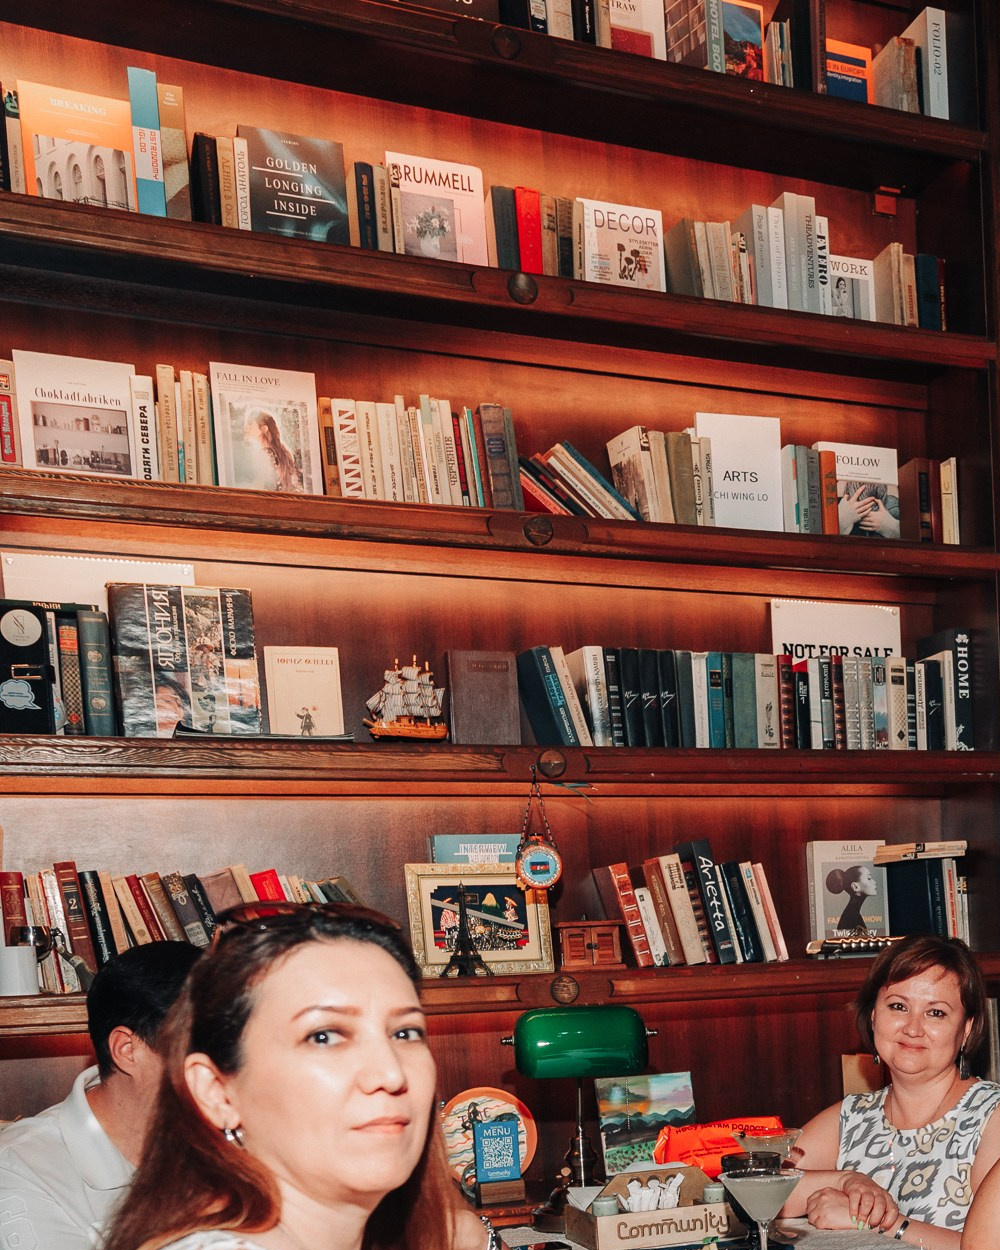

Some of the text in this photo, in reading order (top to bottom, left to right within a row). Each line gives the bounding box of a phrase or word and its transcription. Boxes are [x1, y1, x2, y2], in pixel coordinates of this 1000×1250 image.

[932, 22, 942, 76] FOLIO-02
[50, 97, 107, 116] BREAKING
[221, 156, 231, 192] ЛЕНИН
[266, 156, 317, 174] GOLDEN
[238, 151, 250, 225] ГОРОД АНАТОЛЬ
[264, 177, 323, 196] LONGING
[274, 199, 318, 217] INSIDE
[594, 209, 657, 237] DECOR
[829, 260, 868, 276] WORK
[216, 372, 281, 386] FALL IN LOVE
[138, 405, 149, 445] СЕВЕРА
[445, 436, 458, 486] ЧЕРЧЕНИЕ
[836, 455, 881, 468] FOLLOW
[723, 471, 758, 483] ARTS
[714, 491, 769, 502] CHI WING LO
[152, 589, 176, 669] ЯПОНИЯ
[226, 631, 237, 656] ФОСКО
[782, 643, 893, 660] NOT FOR SALE
[956, 646, 970, 699] HOME
[459, 844, 508, 854] INTERVIEW
[68, 898, 77, 910] 2
[483, 1127, 511, 1137] MENU
[675, 1124, 699, 1135] несу
[617, 1207, 730, 1240] Community
